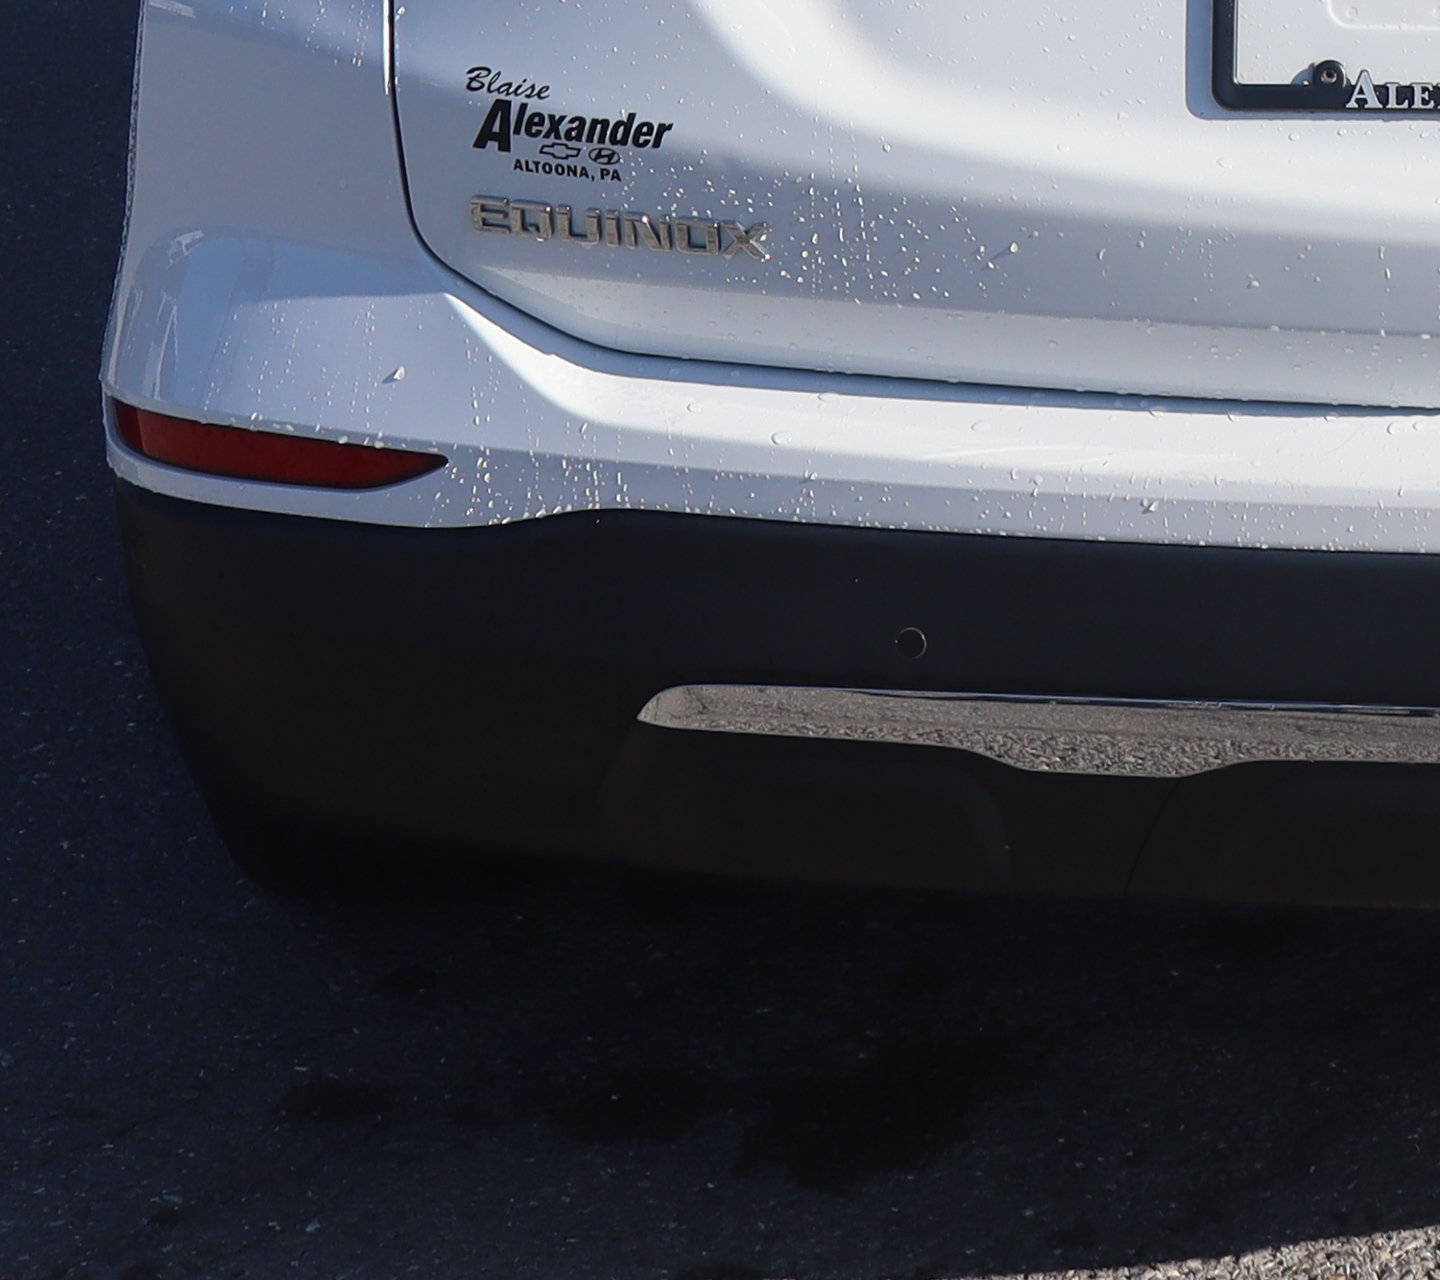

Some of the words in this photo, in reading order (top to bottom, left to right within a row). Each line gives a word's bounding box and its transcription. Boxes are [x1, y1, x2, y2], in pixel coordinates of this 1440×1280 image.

[465, 65, 551, 100] Blaise
[472, 98, 675, 153] Alexander
[513, 158, 596, 183] ALTOONA,
[599, 168, 622, 182] PA
[469, 195, 772, 260] EQUINOX
